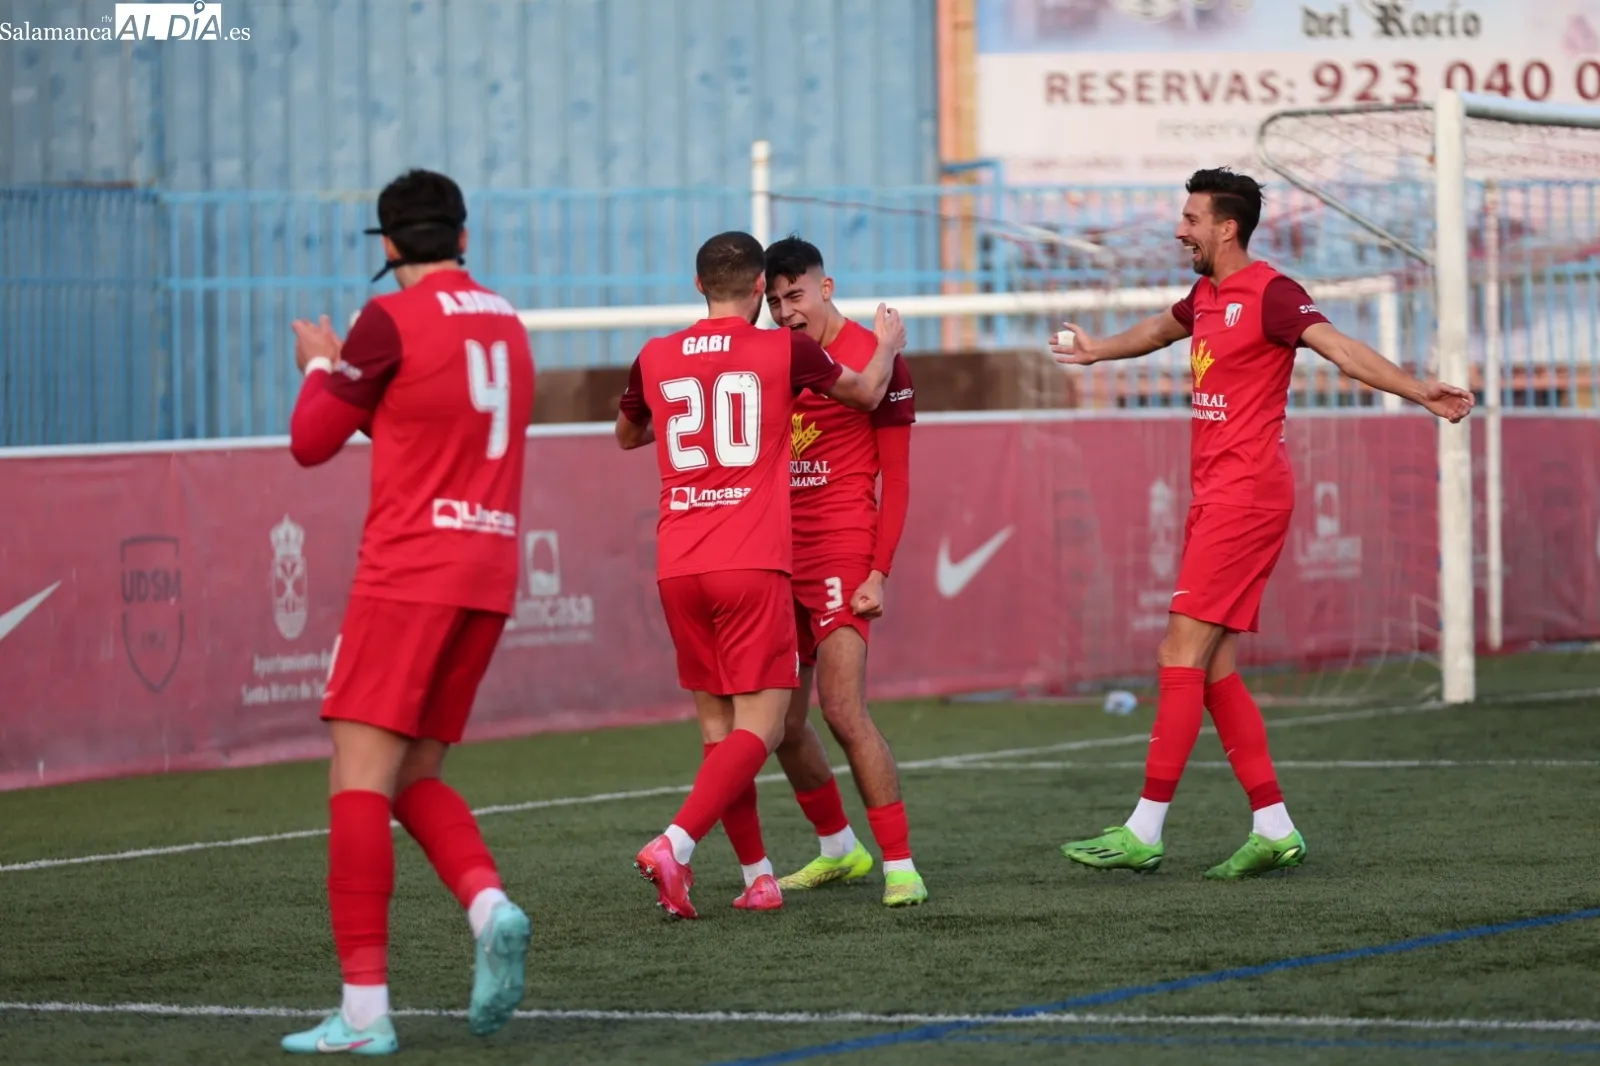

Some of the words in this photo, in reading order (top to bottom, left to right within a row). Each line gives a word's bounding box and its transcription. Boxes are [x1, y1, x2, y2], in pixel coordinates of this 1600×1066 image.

[1302, 5, 1351, 37] del
[1045, 70, 1296, 104] RESERVAS:
[1313, 60, 1420, 102] 923
[1445, 60, 1554, 101] 040
[682, 335, 731, 355] GABI
[465, 339, 511, 460] 4
[660, 371, 762, 471] 20
[690, 486, 752, 504] Lmcasa
[790, 475, 828, 487] MANCA
[824, 576, 844, 610] 3
